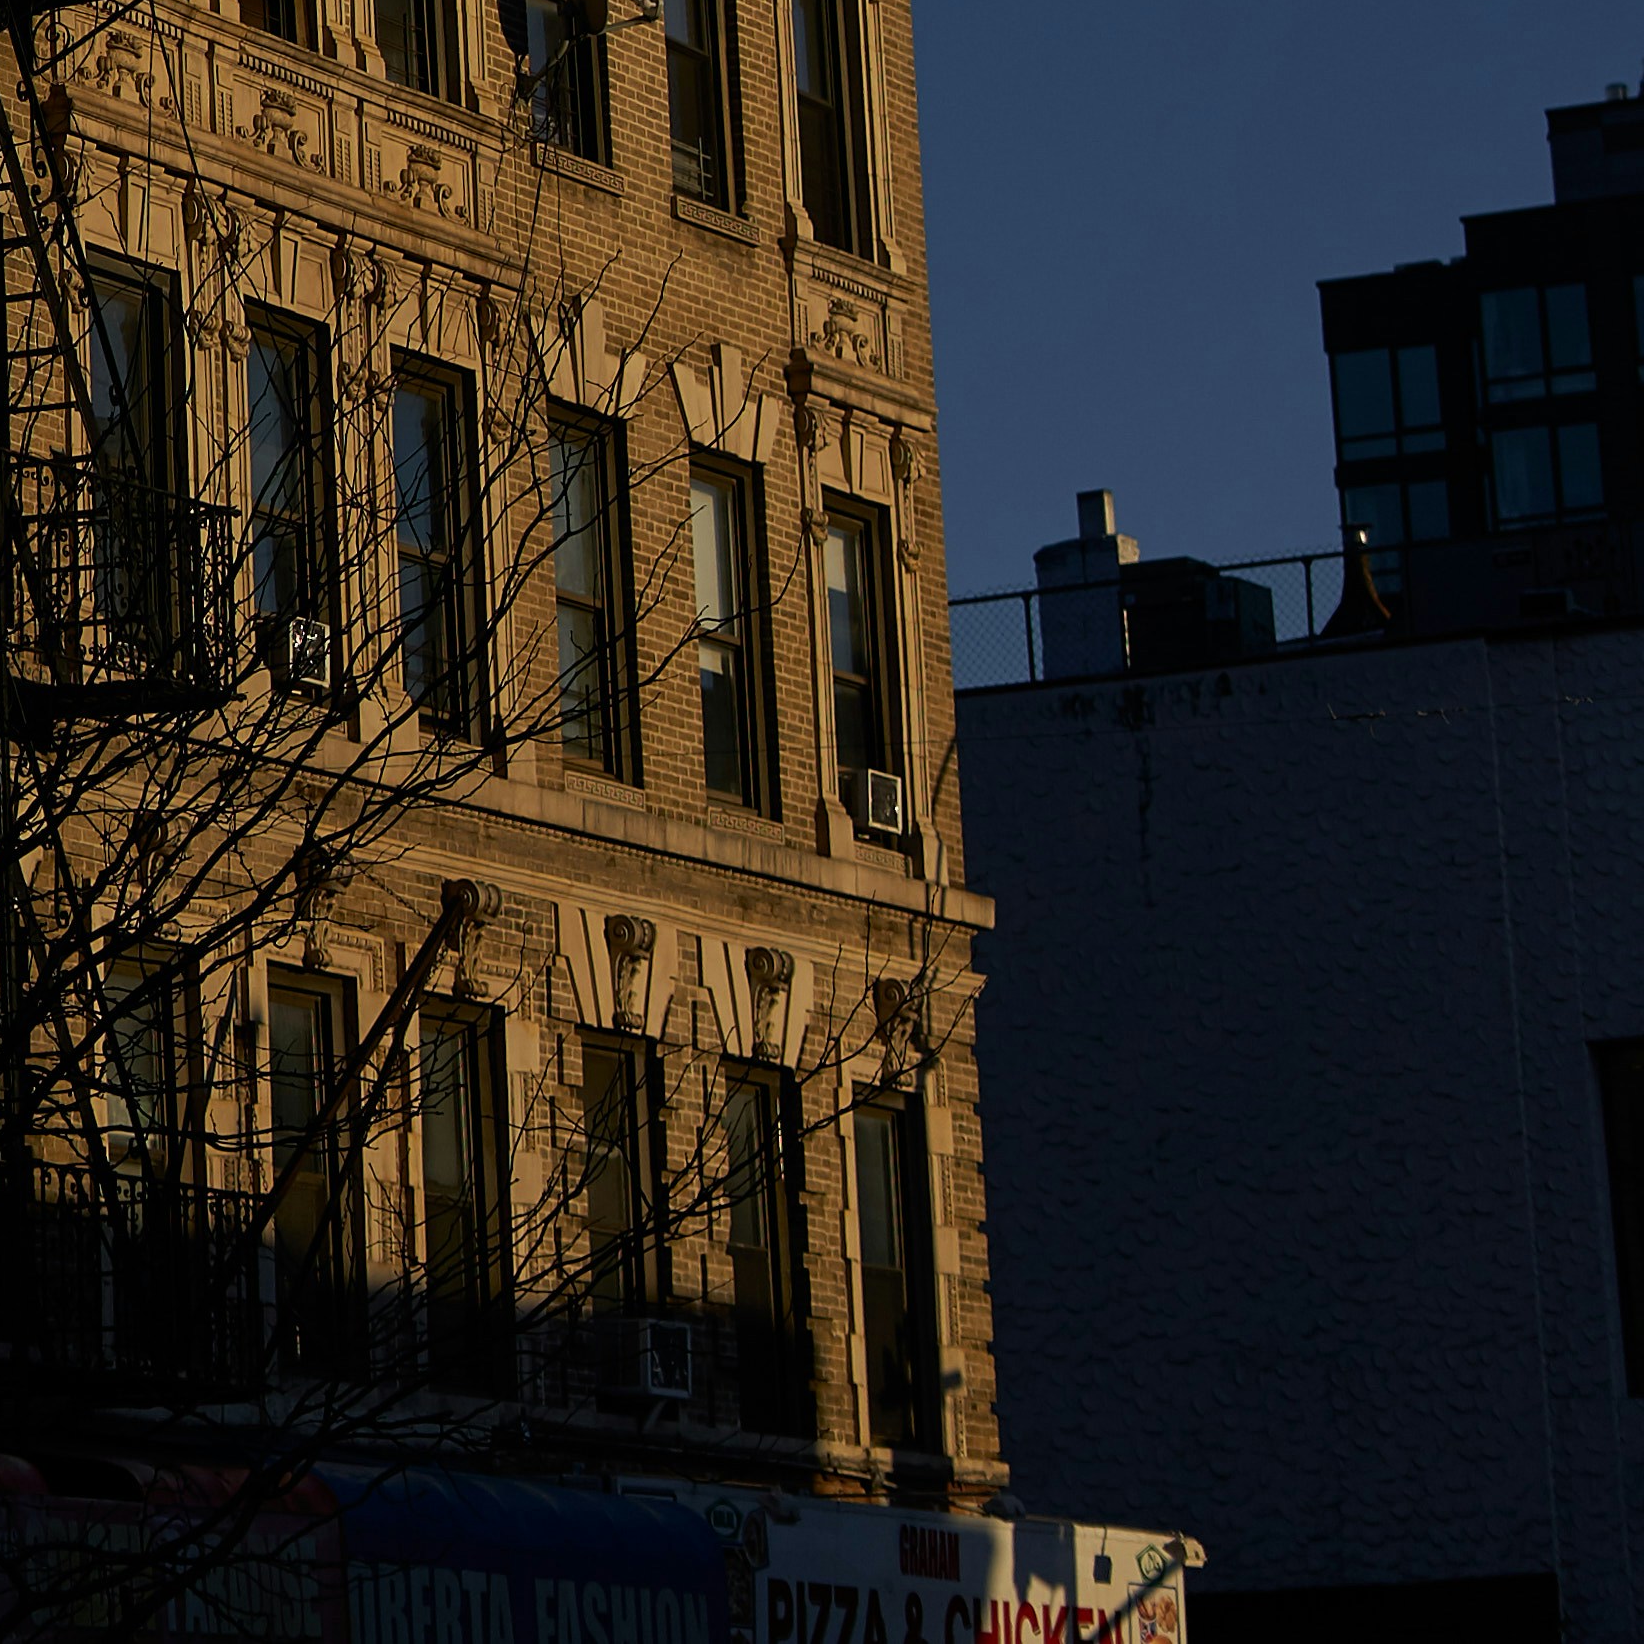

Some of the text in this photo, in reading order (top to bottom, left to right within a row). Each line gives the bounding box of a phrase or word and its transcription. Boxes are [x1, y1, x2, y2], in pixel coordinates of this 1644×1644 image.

[899, 1523, 961, 1582] GRAHAM
[534, 1576, 710, 1644] FASHION
[767, 1577, 888, 1644] PIZZA
